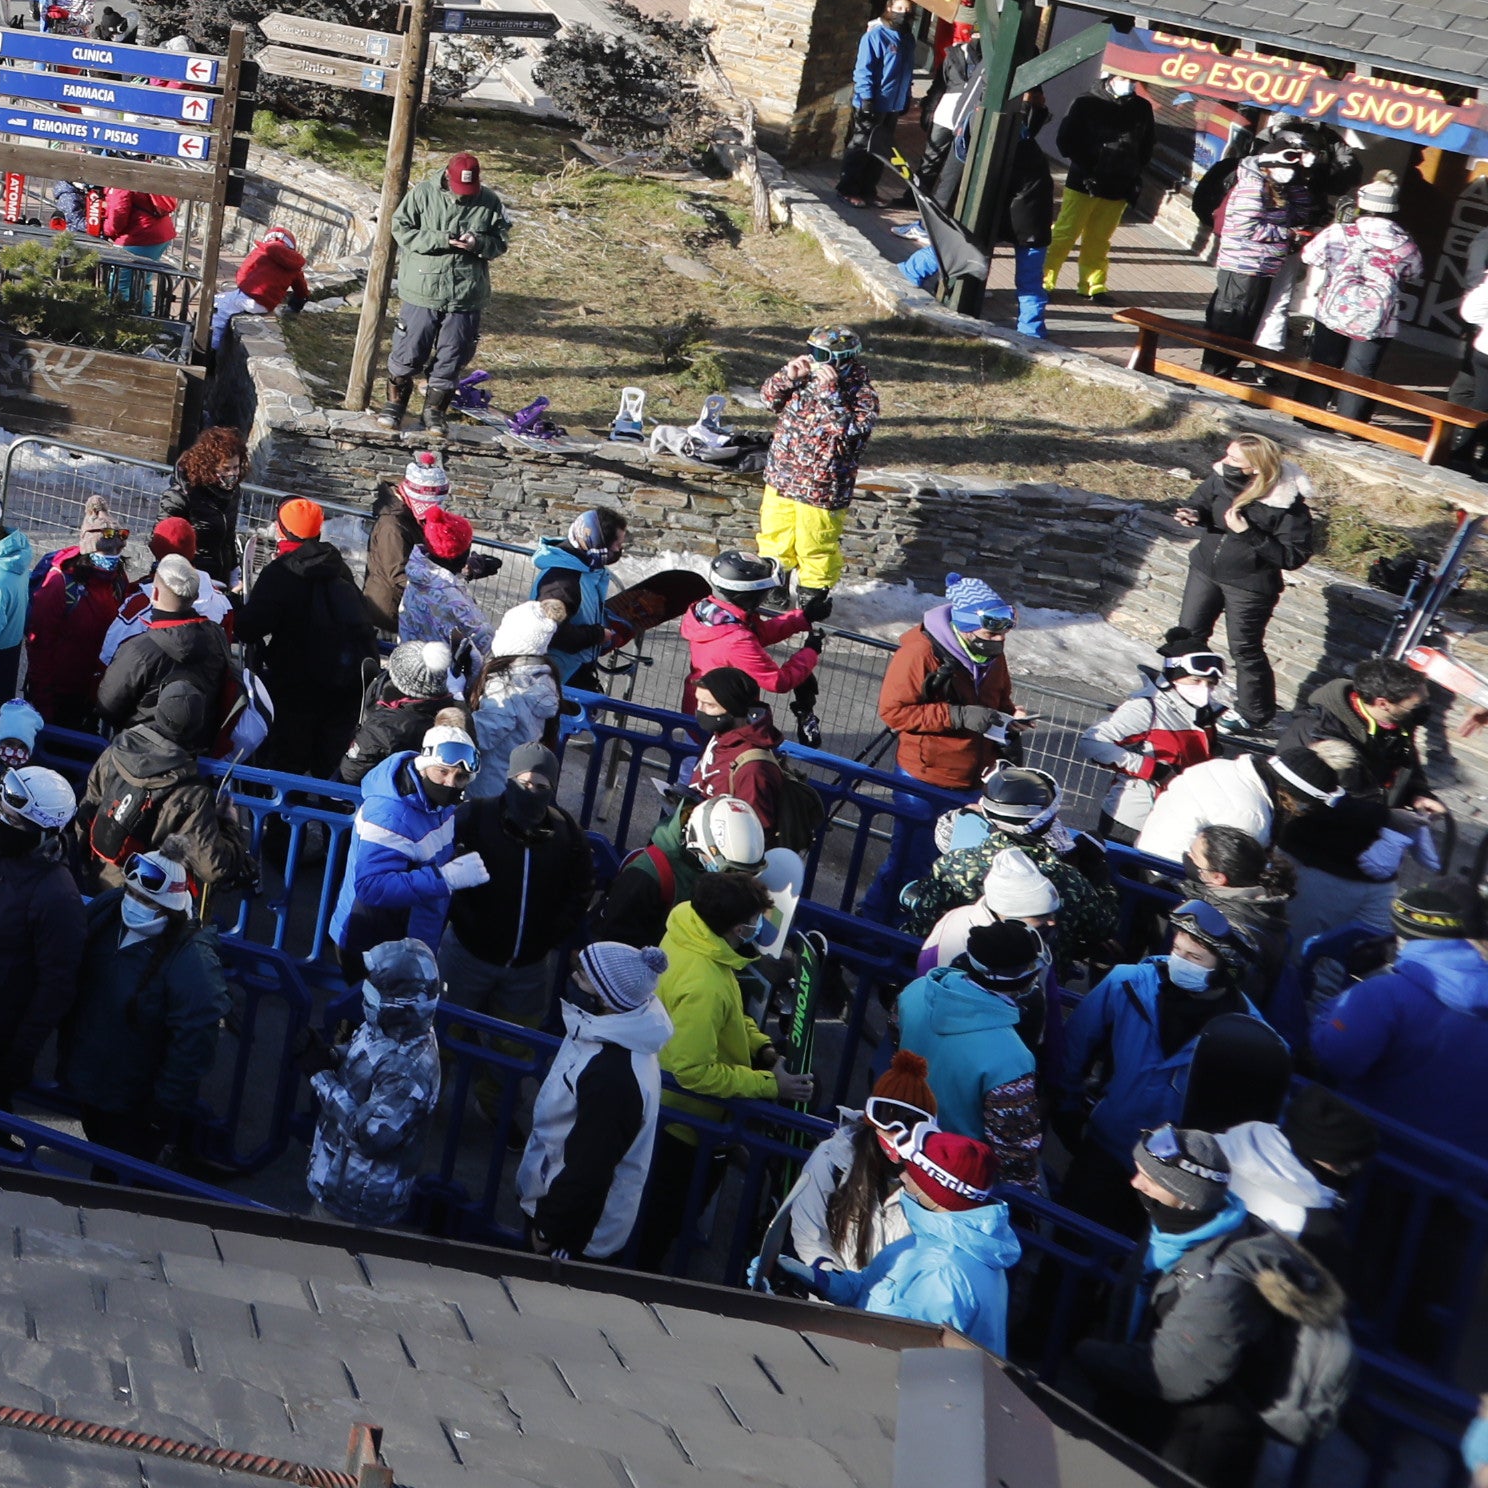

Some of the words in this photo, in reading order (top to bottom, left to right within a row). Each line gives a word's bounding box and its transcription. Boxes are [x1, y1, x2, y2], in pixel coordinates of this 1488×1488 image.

[325, 32, 332, 42] y
[71, 47, 113, 64] CLINICA
[63, 84, 115, 102] FARMACIA
[1160, 53, 1200, 81] de
[1207, 62, 1315, 104] ESQUÍ
[1310, 90, 1336, 116] y
[1341, 91, 1454, 136] SNOW
[32, 118, 88, 138] REMONTES
[92, 127, 101, 139] Y
[104, 128, 139, 146] PISTAS
[7, 177, 19, 222] ATOMIC
[792, 965, 810, 1048] ATOMIC
